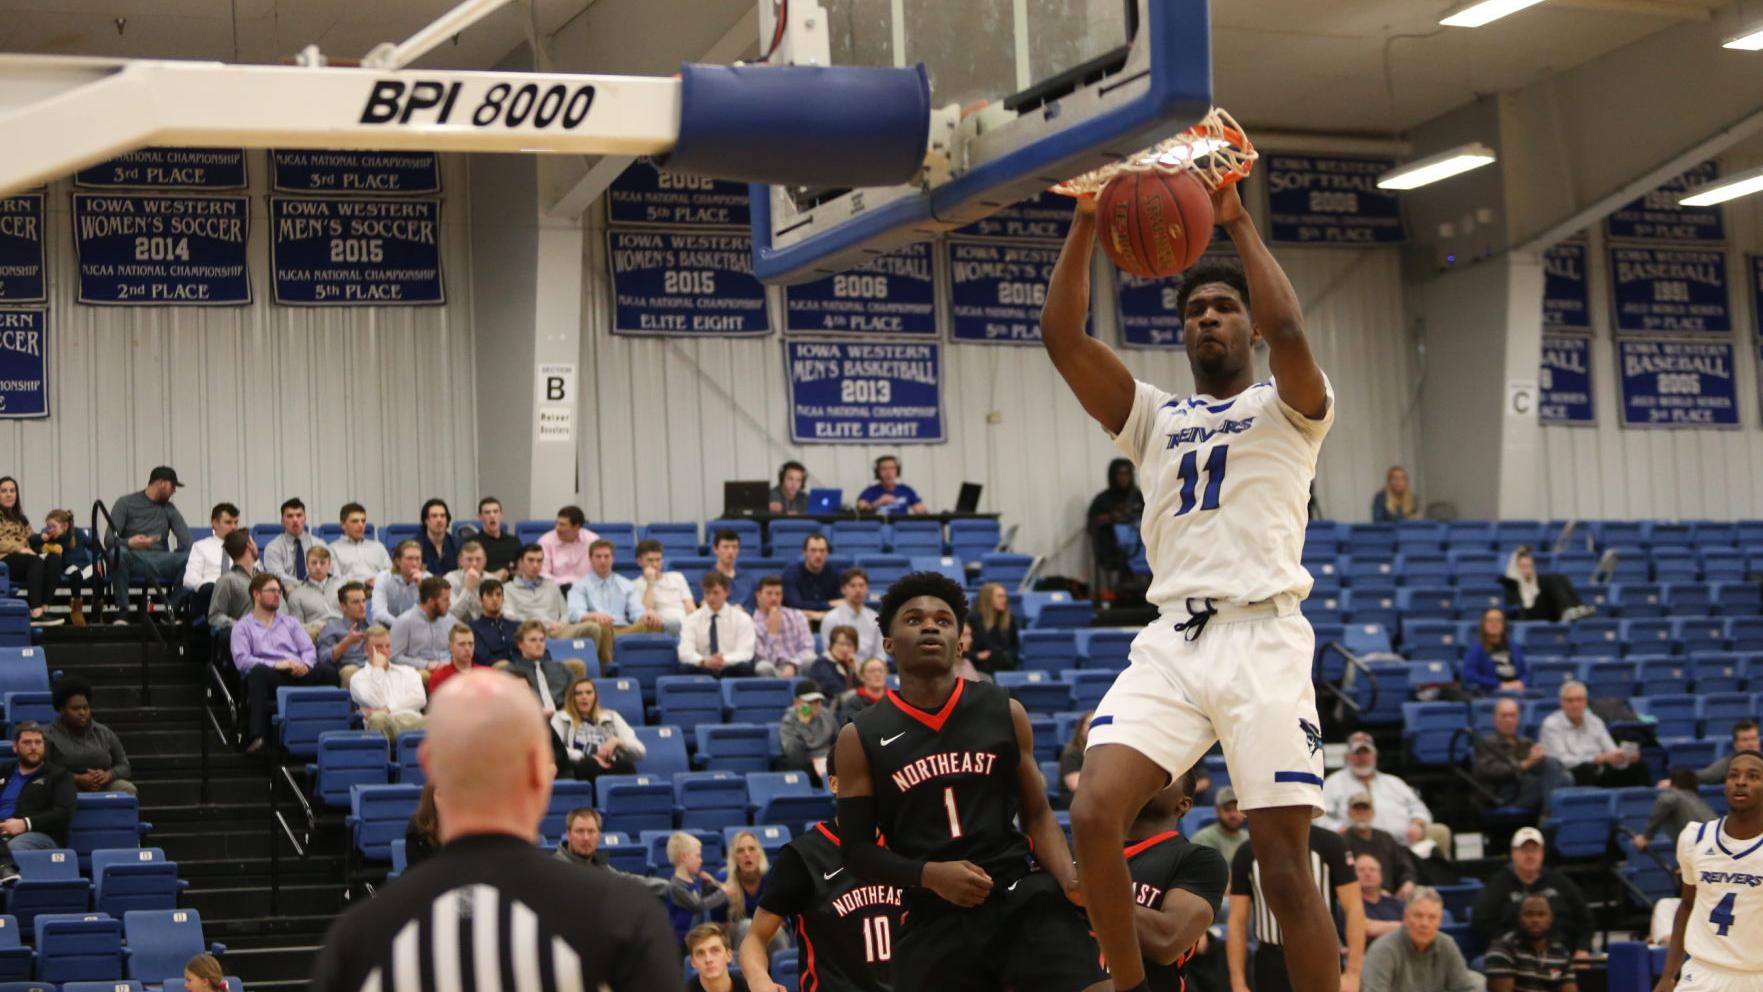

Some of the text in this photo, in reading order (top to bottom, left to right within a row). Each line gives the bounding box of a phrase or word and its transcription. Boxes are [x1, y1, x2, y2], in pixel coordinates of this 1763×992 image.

[360, 81, 596, 129] BPI 8000
[168, 152, 240, 165] CHAMPIONSHIP
[311, 155, 359, 166] NATIONAL
[362, 156, 432, 169] CHAMPIONSHIP
[113, 168, 206, 183] 3rd PLACE
[309, 174, 400, 189] 3rd PLACE
[86, 200, 236, 215] IOWA WESTERN
[282, 201, 428, 217] IOWA WESTERN
[675, 207, 730, 222] PLACE
[81, 215, 242, 242] WOMEN'S SOCCER
[278, 218, 435, 244] MEN'S SOCCER
[1007, 222, 1059, 235] PLACE
[135, 237, 190, 261] 2014
[619, 235, 663, 247] IOWA
[330, 239, 384, 263] 2015
[956, 247, 1059, 263] IOWA WESTE
[82, 264, 243, 278] NJCAA NATIONAL CHAMPIONSHIP
[613, 250, 753, 273] WOMEN'S BASKETBAL
[278, 270, 436, 281] NJCAA NATIONAL CHAMPIONSHIP
[664, 271, 715, 293] 2015
[1617, 263, 1722, 286] BASEBALL
[117, 284, 209, 299] 2nd PLACE
[315, 284, 402, 299] 5th PLACE
[998, 282, 1046, 305] 2016
[640, 314, 744, 330] ELITE EIGHT
[850, 316, 903, 331] PLACE
[1012, 325, 1042, 339] PLA
[797, 345, 930, 359] IOWA WESTERN
[793, 360, 936, 385] MEN'S BASKETBALL
[1625, 354, 1730, 379] BASEBALL
[547, 377, 565, 401] B
[841, 380, 891, 403] 2013
[1513, 391, 1530, 415] C
[815, 422, 919, 437] ELITE EIGHT
[1174, 444, 1229, 517] 11
[891, 751, 997, 793] NORTHEAST
[944, 786, 963, 838] 1
[1700, 871, 1763, 887] REIVERS
[832, 884, 904, 918] NORTHEAS
[1709, 892, 1738, 937] 4
[863, 915, 892, 963] 10
